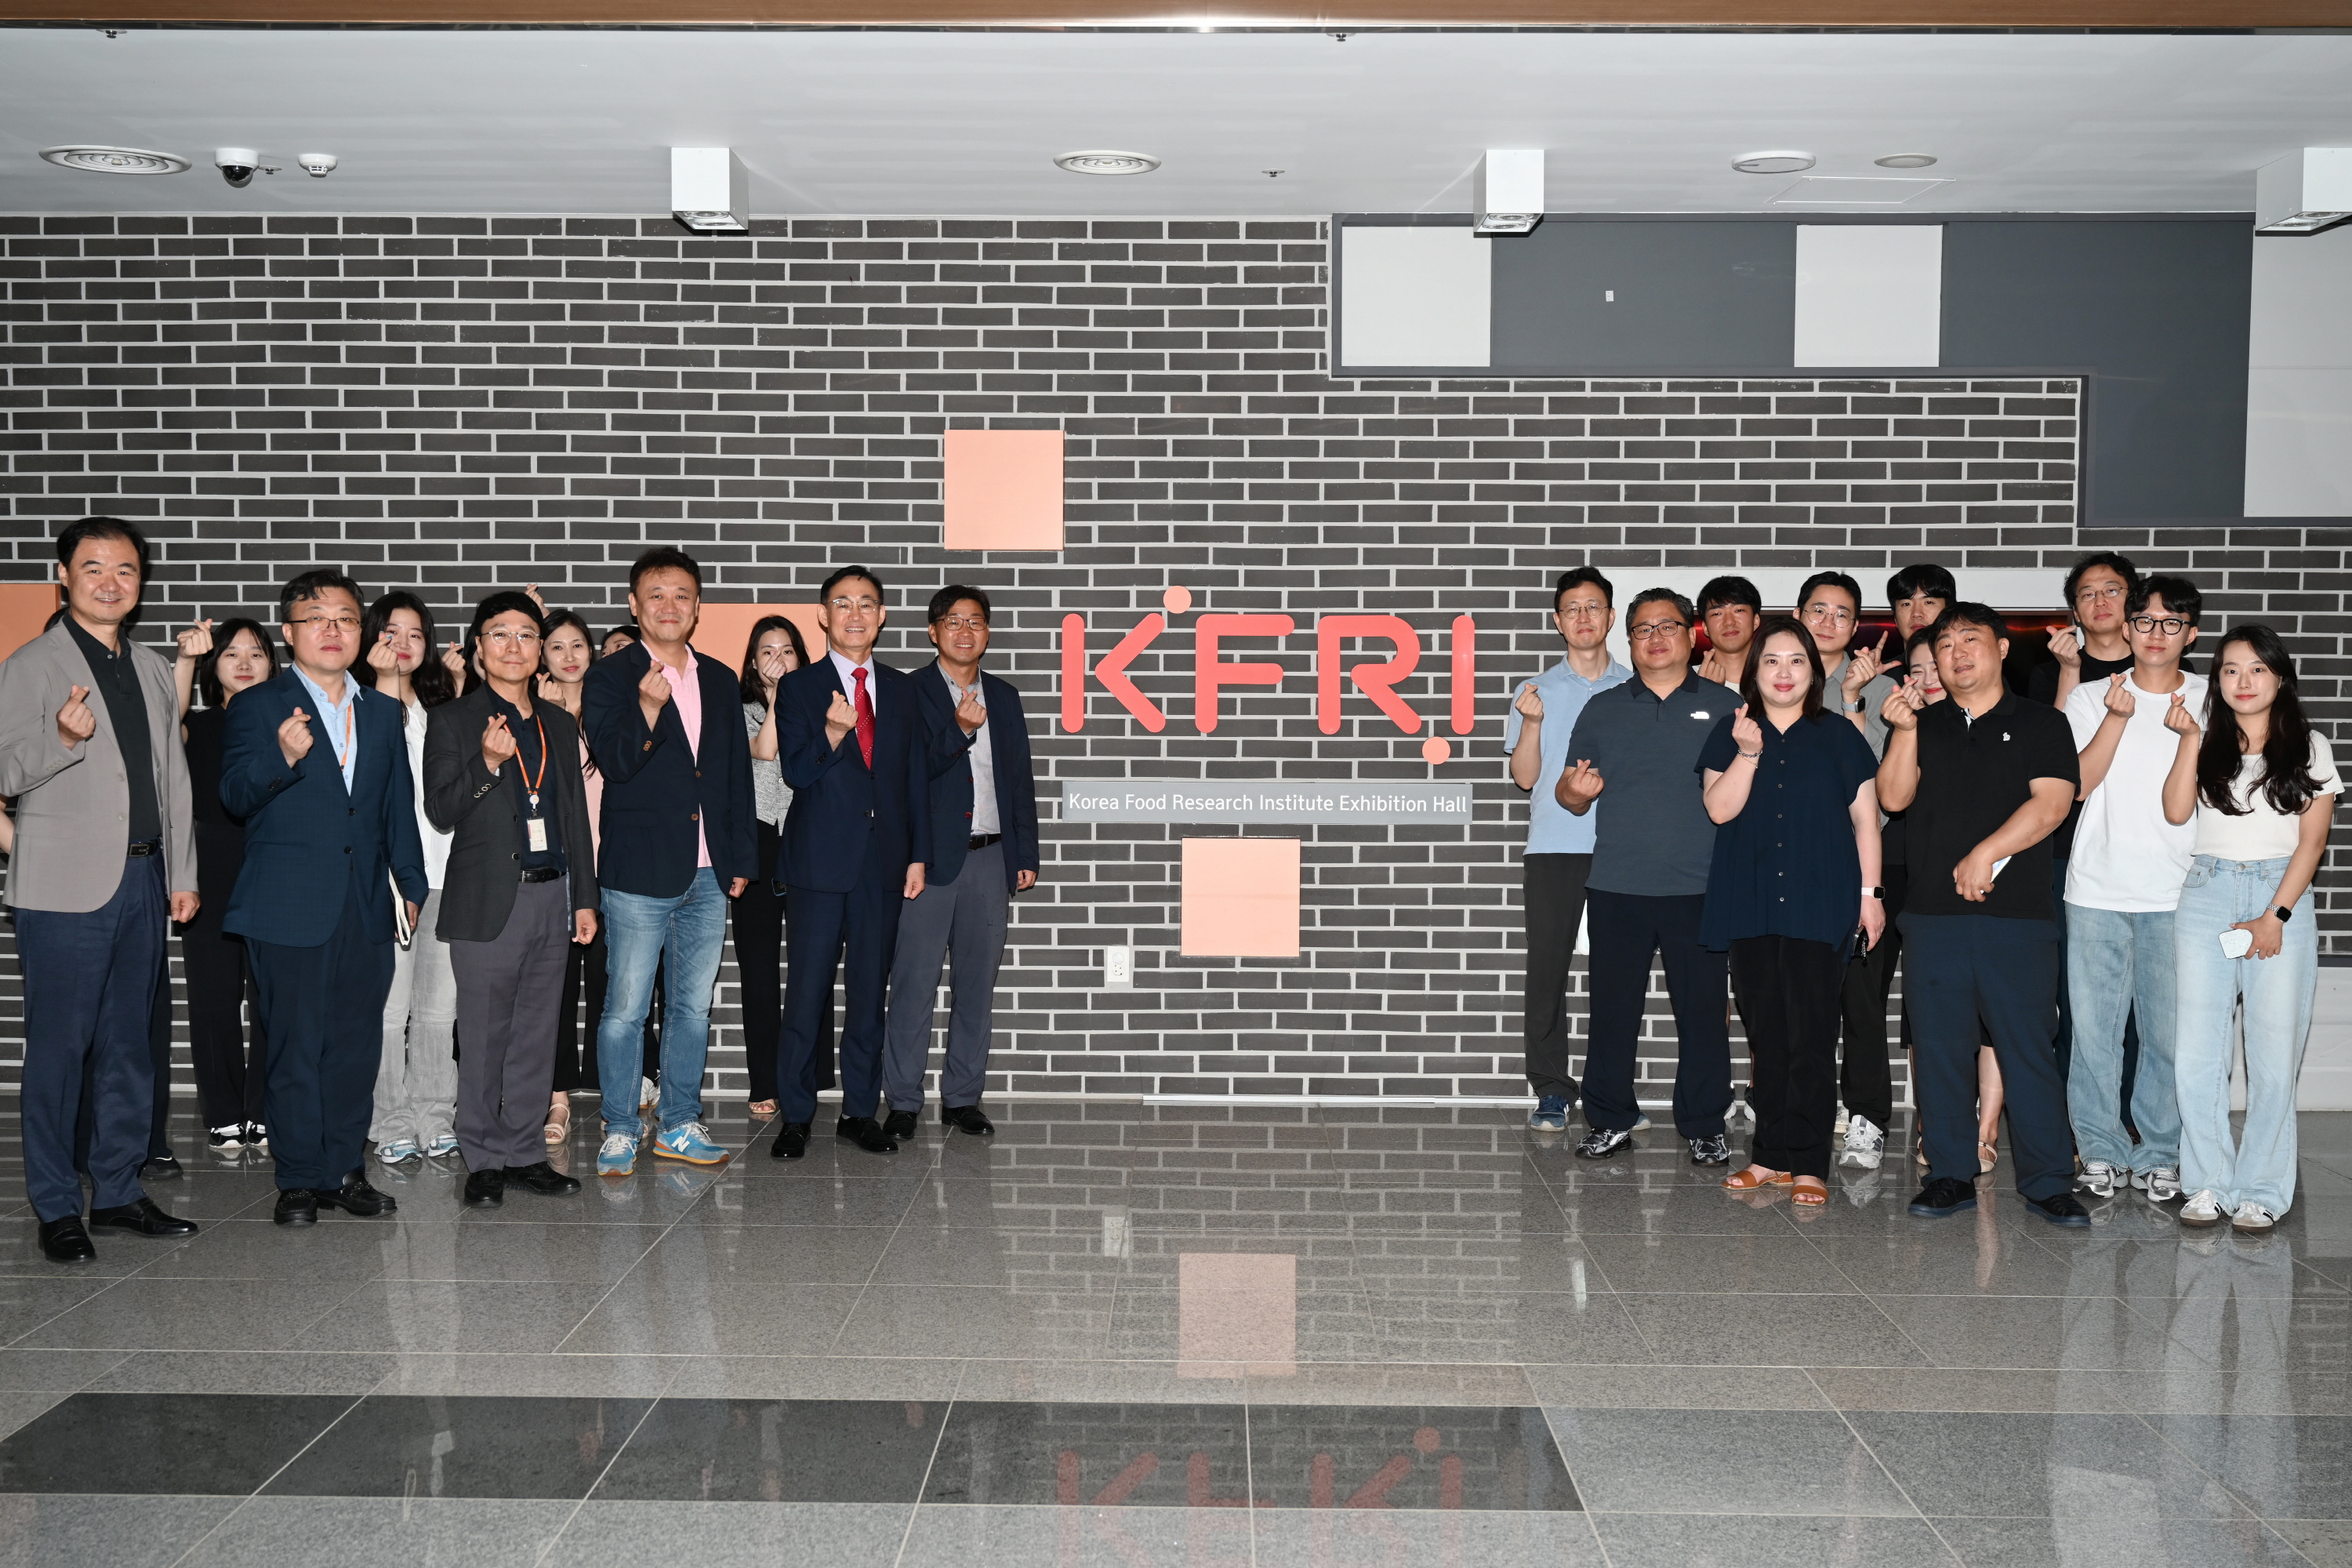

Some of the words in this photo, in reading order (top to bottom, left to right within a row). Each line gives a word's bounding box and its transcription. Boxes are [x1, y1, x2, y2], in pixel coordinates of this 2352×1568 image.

[1061, 613, 1475, 735] KFRI
[1069, 793, 1119, 809] Korea
[1125, 793, 1167, 810] Food
[1173, 793, 1253, 810] Research
[1260, 793, 1333, 811] Institute
[1339, 794, 1426, 811] Exhibition
[1433, 796, 1466, 812] Hall
